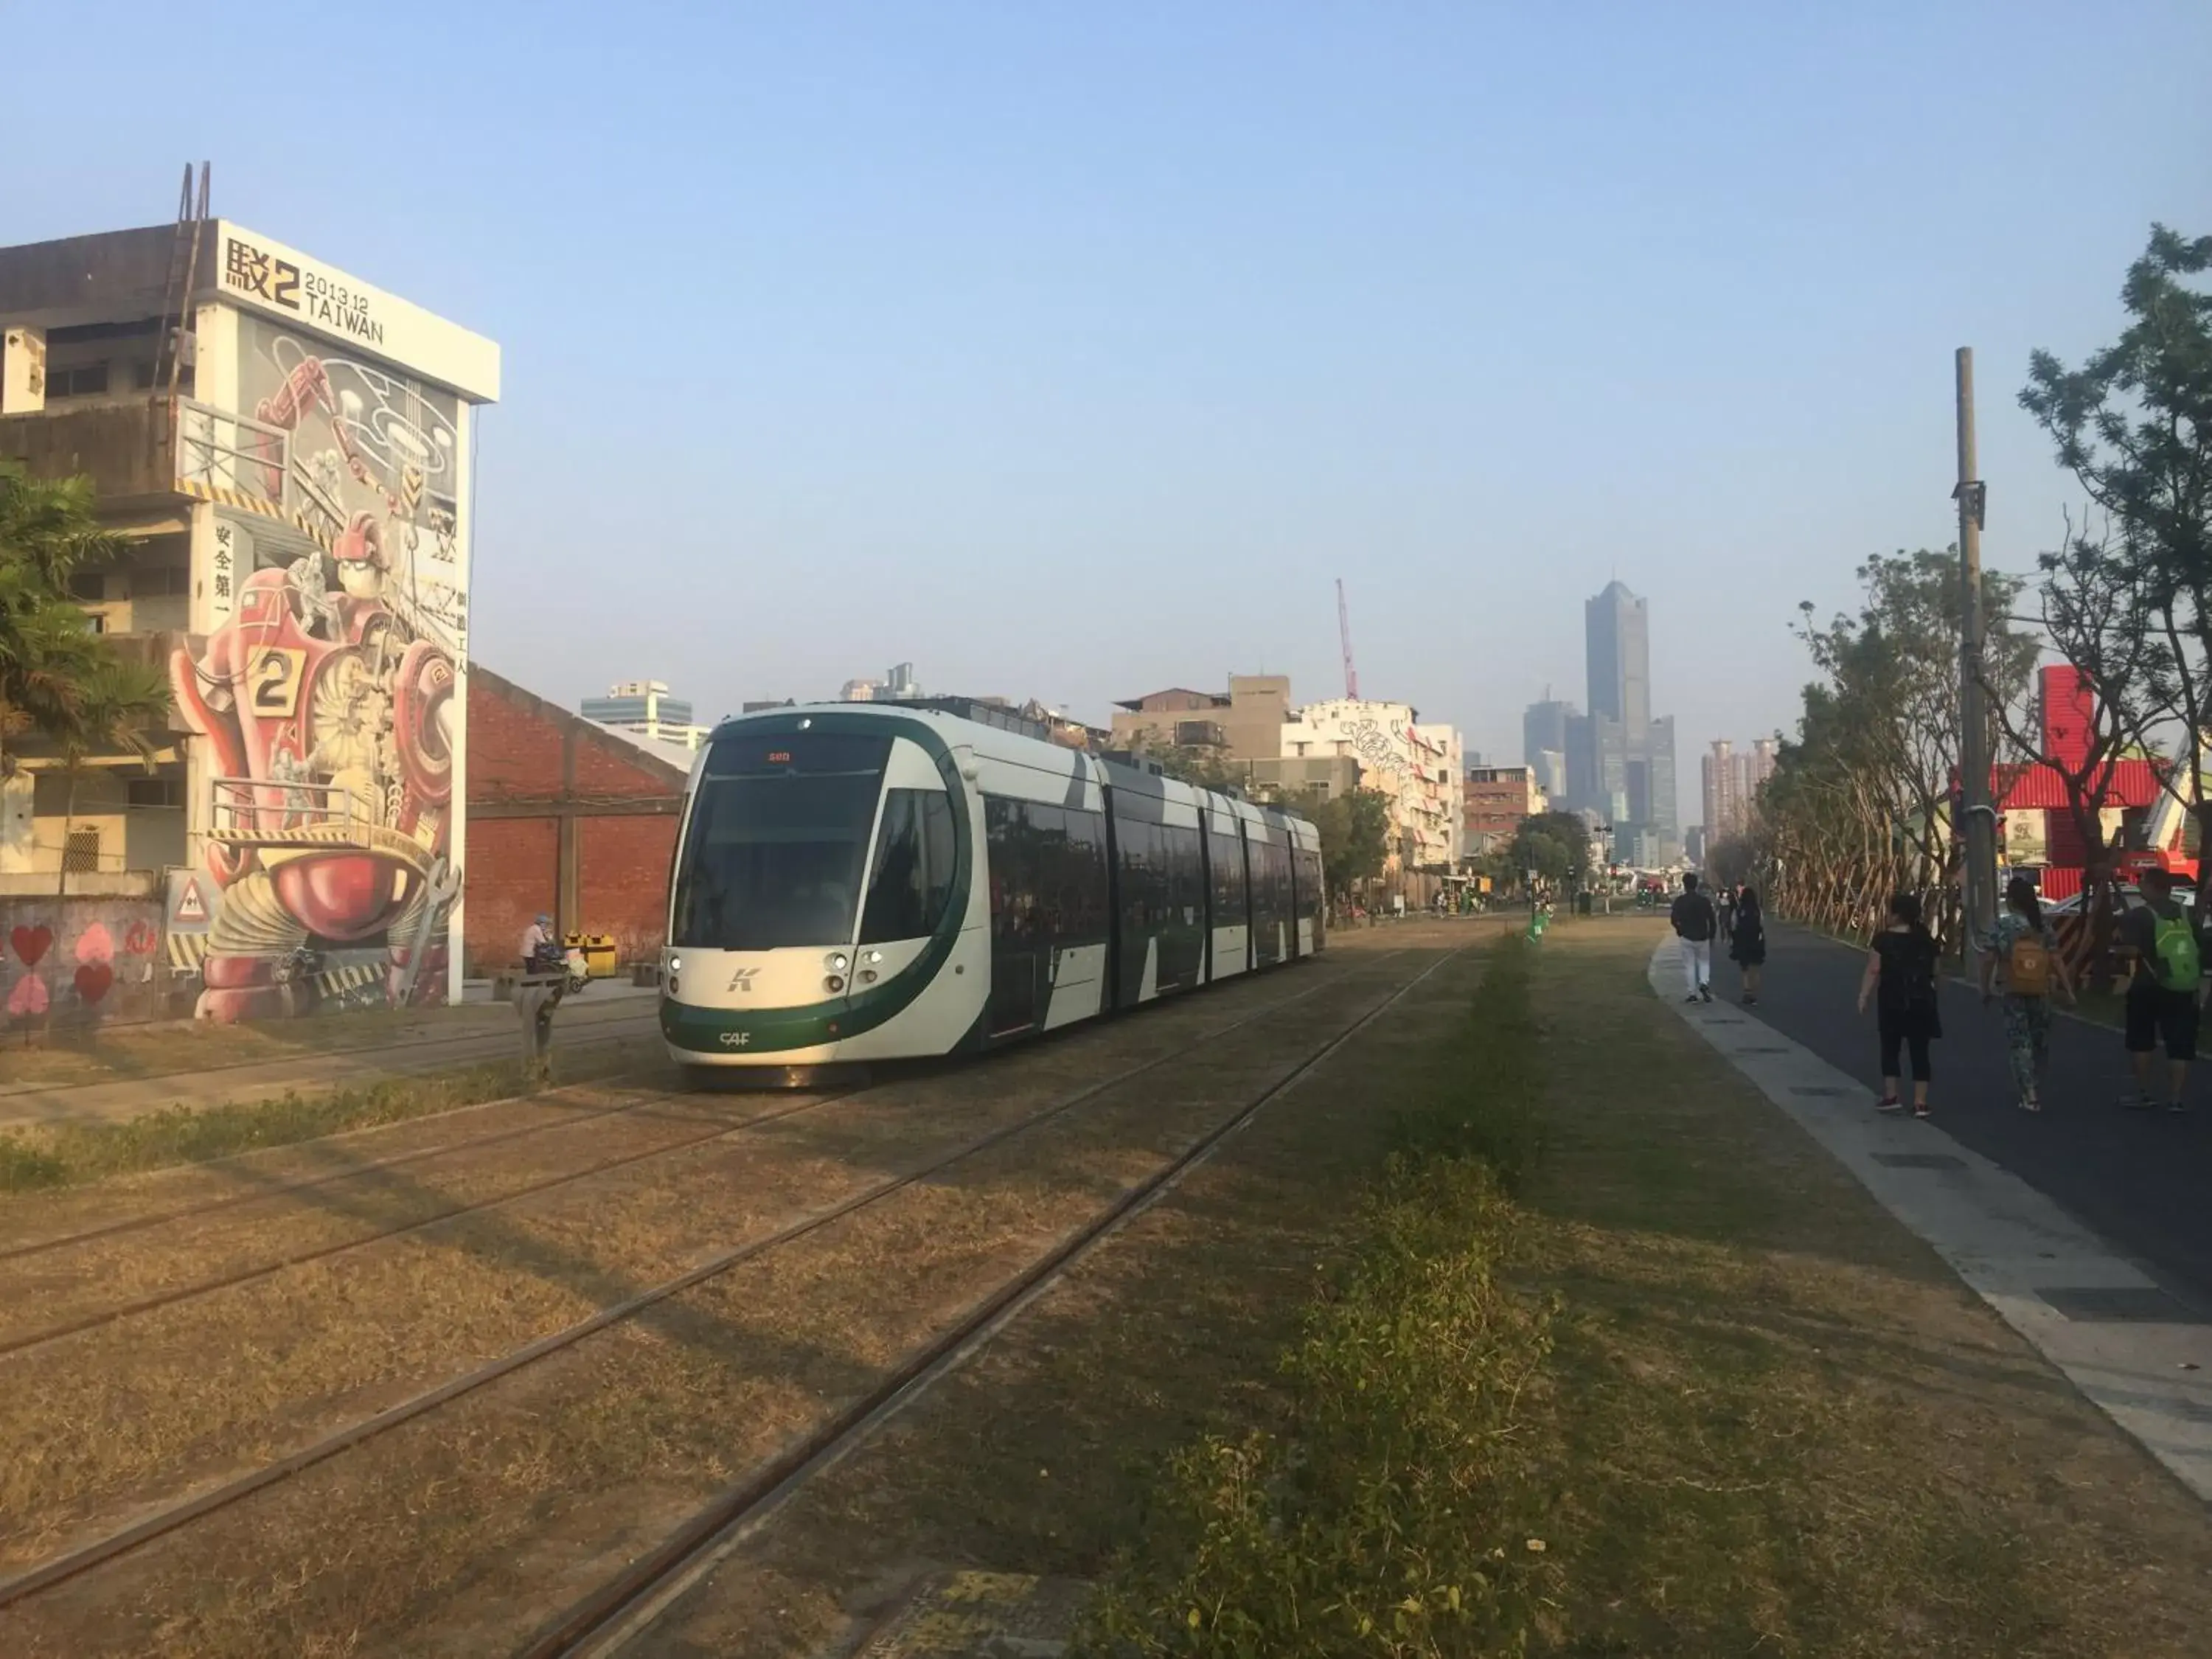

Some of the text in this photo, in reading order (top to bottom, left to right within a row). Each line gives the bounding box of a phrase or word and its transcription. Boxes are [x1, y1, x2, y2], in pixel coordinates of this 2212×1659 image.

[305, 272, 369, 316] 2013.12
[305, 291, 383, 345] TAIWAN
[214, 526, 232, 612] 安全第一
[255, 650, 293, 708] 2
[720, 1032, 750, 1046] CAF
